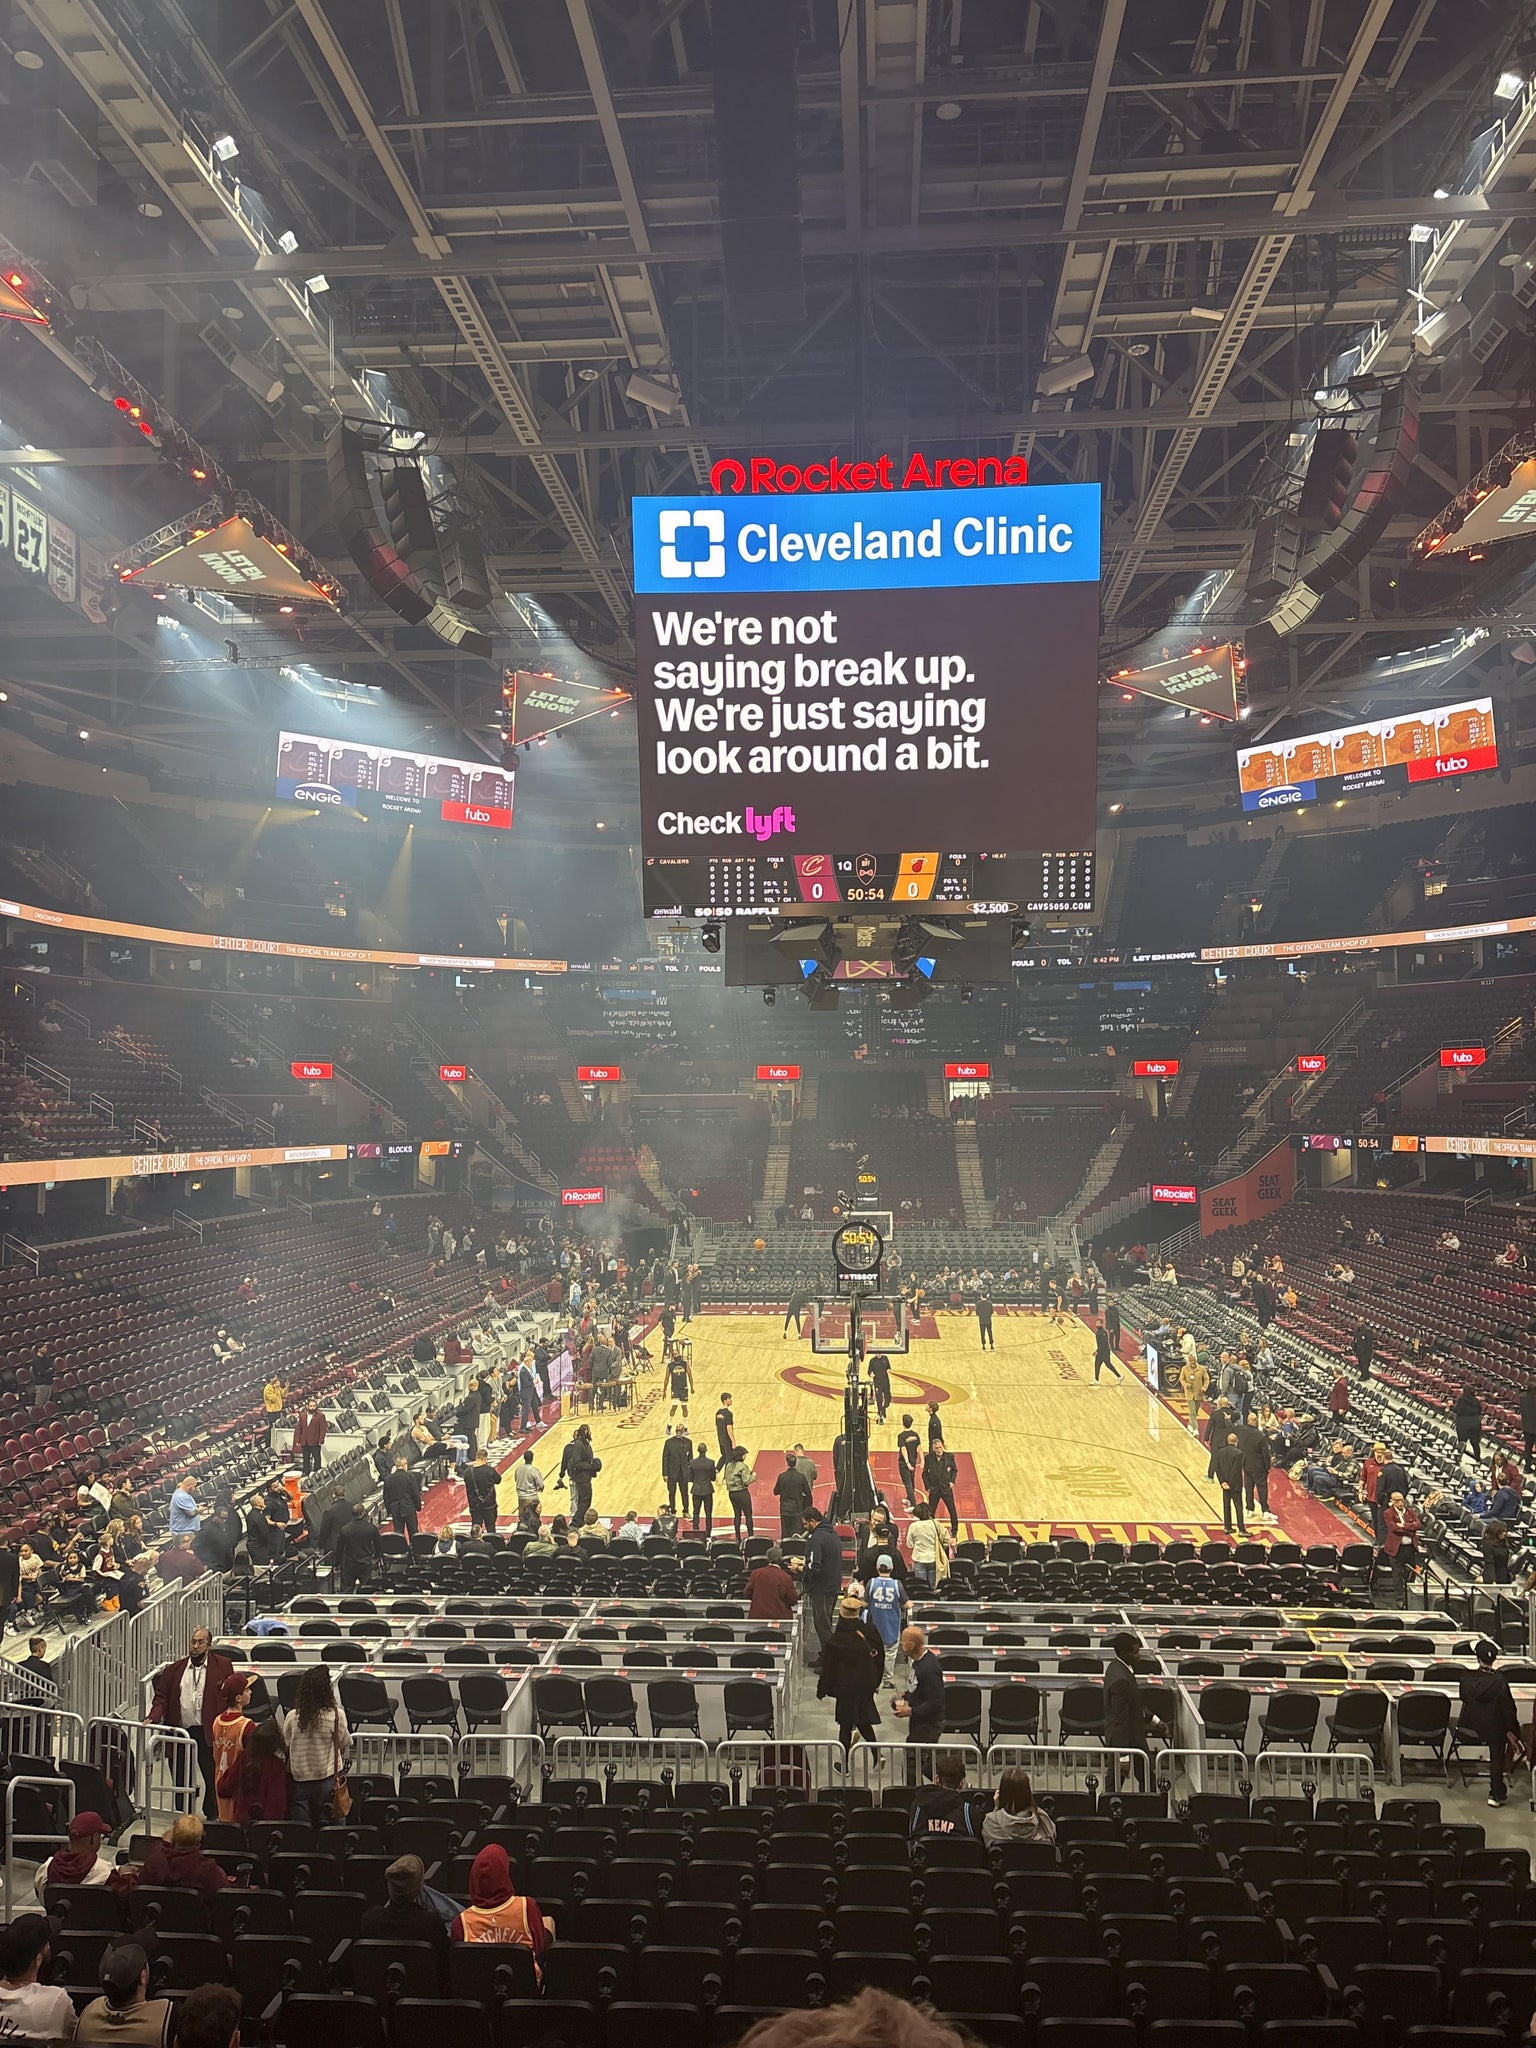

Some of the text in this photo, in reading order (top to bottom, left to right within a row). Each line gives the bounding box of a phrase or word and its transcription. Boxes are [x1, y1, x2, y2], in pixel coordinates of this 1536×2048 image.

[751, 452, 1028, 493] Rocket Arena
[17, 518, 43, 568] 27
[737, 515, 1073, 562] Cleveland Clinic
[221, 549, 254, 567] LET
[652, 610, 838, 646] We're not
[653, 651, 975, 697] saying break up.
[1160, 664, 1214, 687] LET EM
[1166, 671, 1224, 695] KNOW.
[529, 690, 580, 706] LET EM
[523, 697, 575, 715] KNOW.
[654, 692, 986, 738] We're just saying
[656, 735, 989, 775] look around a bit.
[1435, 757, 1468, 774] fubo
[1344, 771, 1372, 781] WELCOME
[1342, 783, 1364, 791] ROCKET
[385, 794, 411, 804] WELCOME
[464, 807, 491, 822] fubo
[657, 806, 796, 842] Check lyft
[838, 861, 852, 871] 1Q
[812, 884, 823, 899] 0
[847, 888, 884, 901] 50:54
[908, 882, 919, 897] 0
[654, 906, 682, 916] oswald
[736, 907, 780, 917] RAFFLE
[973, 903, 1009, 914] $2,500
[1027, 902, 1091, 911] CAVS5050.COM
[212, 937, 248, 950] CENTER
[252, 940, 280, 953] COURT
[297, 947, 322, 955] OFFICIAL
[323, 948, 340, 956] TEAM
[340, 950, 357, 958] SHOP
[1201, 947, 1240, 960] CENTER
[1244, 944, 1275, 957] COURT
[1295, 943, 1322, 951] OFFICIAL
[1324, 941, 1341, 950] TEAM
[1341, 940, 1359, 948] SHOP
[1077, 957, 1082, 965] 7
[1166, 951, 1197, 960] KNOW.
[1040, 959, 1047, 967] 0
[699, 965, 721, 973] FOULS
[1453, 1052, 1473, 1062] fubo
[1146, 1063, 1166, 1072] fubo
[1302, 1058, 1322, 1069] fubo
[303, 1066, 322, 1076] fubo
[443, 1069, 462, 1078] fubo
[590, 1069, 608, 1078] fubo
[769, 1068, 788, 1077] fubo
[957, 1066, 977, 1075] fubo
[1333, 1139, 1340, 1148] 0
[1358, 1139, 1379, 1148] 50:54
[1394, 1140, 1399, 1148] 0
[1446, 1138, 1469, 1152] CENTER
[1472, 1139, 1490, 1153] COURT
[375, 1146, 380, 1155] 0
[388, 1146, 413, 1154] BLOCKS
[132, 1155, 163, 1174] CENTER
[166, 1153, 191, 1171] COURT
[195, 1157, 204, 1165] THE
[204, 1155, 222, 1165] OFFICIAL
[224, 1154, 236, 1163] TEAM
[1258, 1174, 1280, 1187] SEAT
[573, 1191, 601, 1200] Rocket
[1163, 1189, 1194, 1199] Rocket
[1258, 1187, 1282, 1200] GEEK
[516, 1200, 556, 1208] LECOM
[1212, 1198, 1236, 1207] SEAT
[1212, 1207, 1238, 1216] GEEK
[842, 1232, 874, 1244] 50:54
[873, 1586, 894, 1602] 45
[928, 1819, 955, 1833] KEMP
